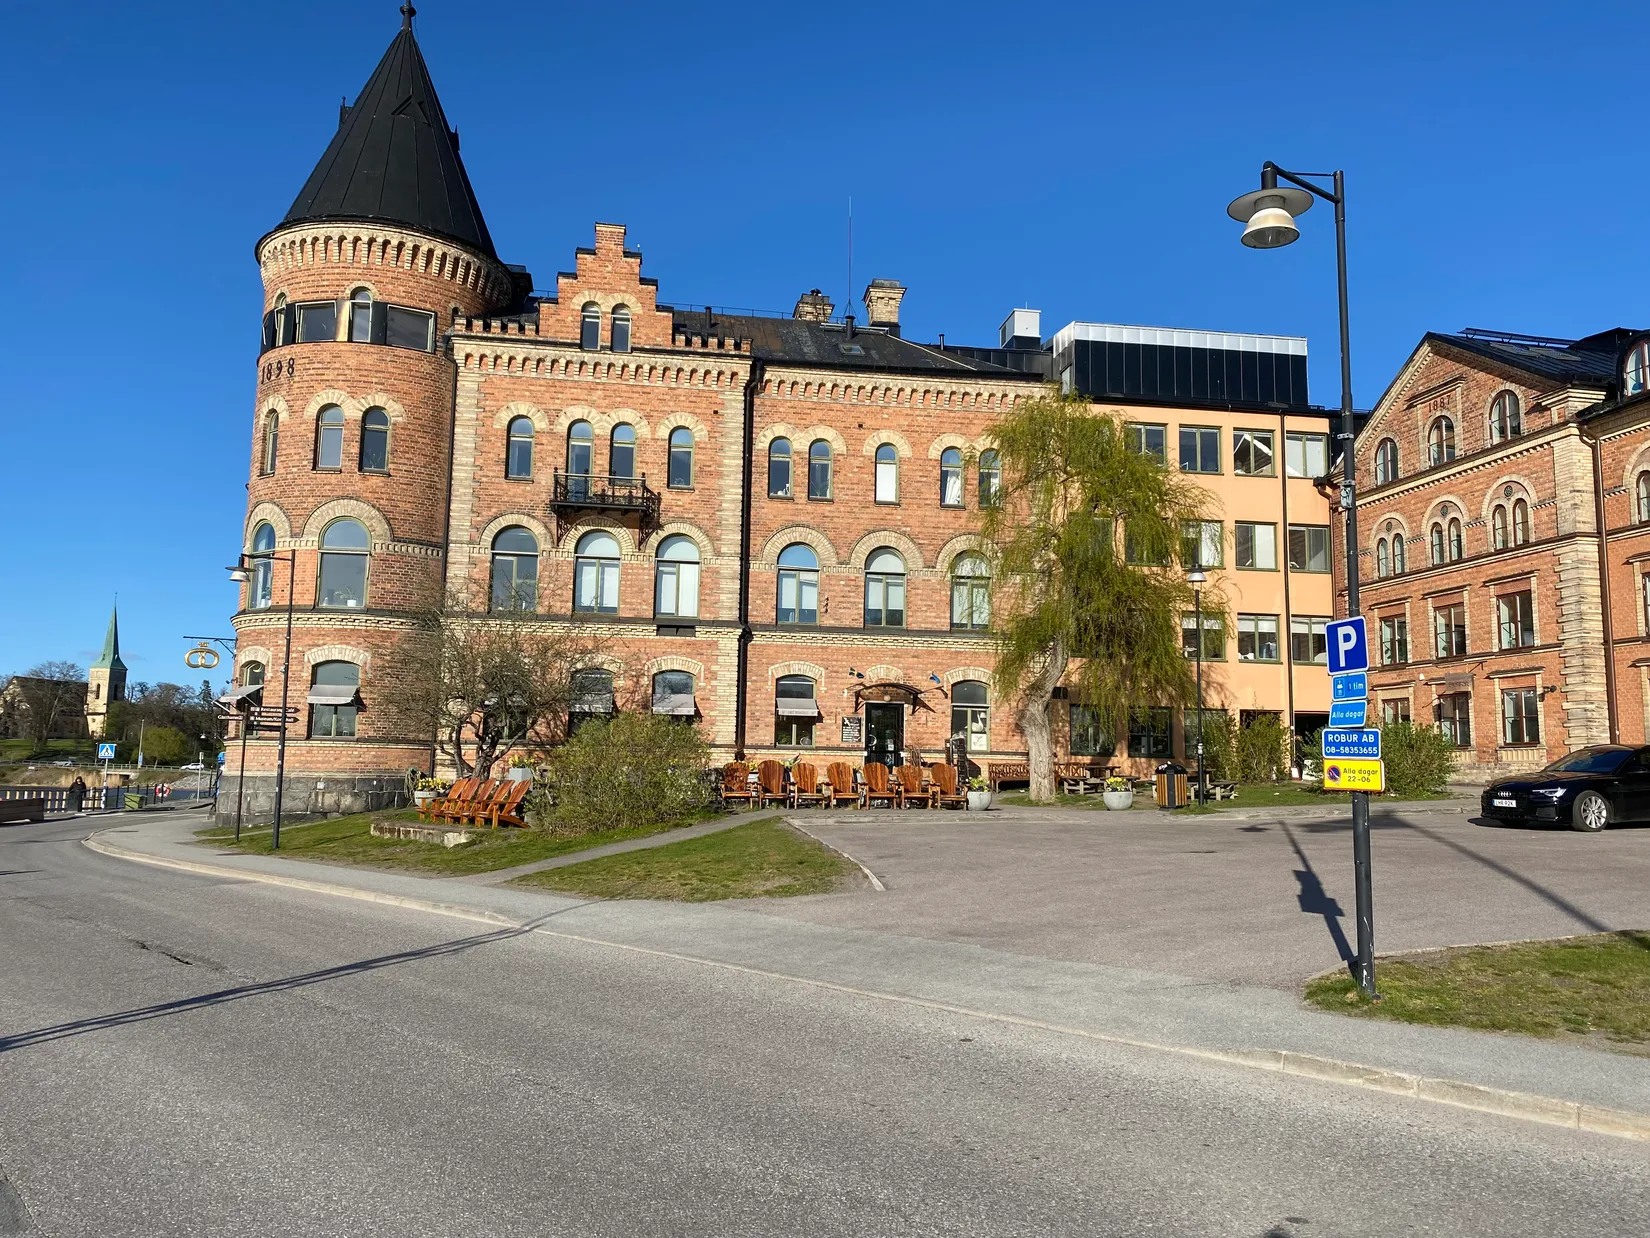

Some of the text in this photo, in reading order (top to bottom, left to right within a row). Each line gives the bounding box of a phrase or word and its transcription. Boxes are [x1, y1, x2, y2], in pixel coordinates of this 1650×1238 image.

[261, 357, 295, 384] 1898
[1428, 395, 1451, 413] 1887
[1337, 625, 1357, 668] P
[1353, 681, 1364, 690] tim
[1332, 710, 1364, 720] Alla dagar
[1328, 734, 1375, 743] ROBUR AB
[1325, 746, 1378, 755] 08-58353655
[1358, 768, 1378, 777] dagar
